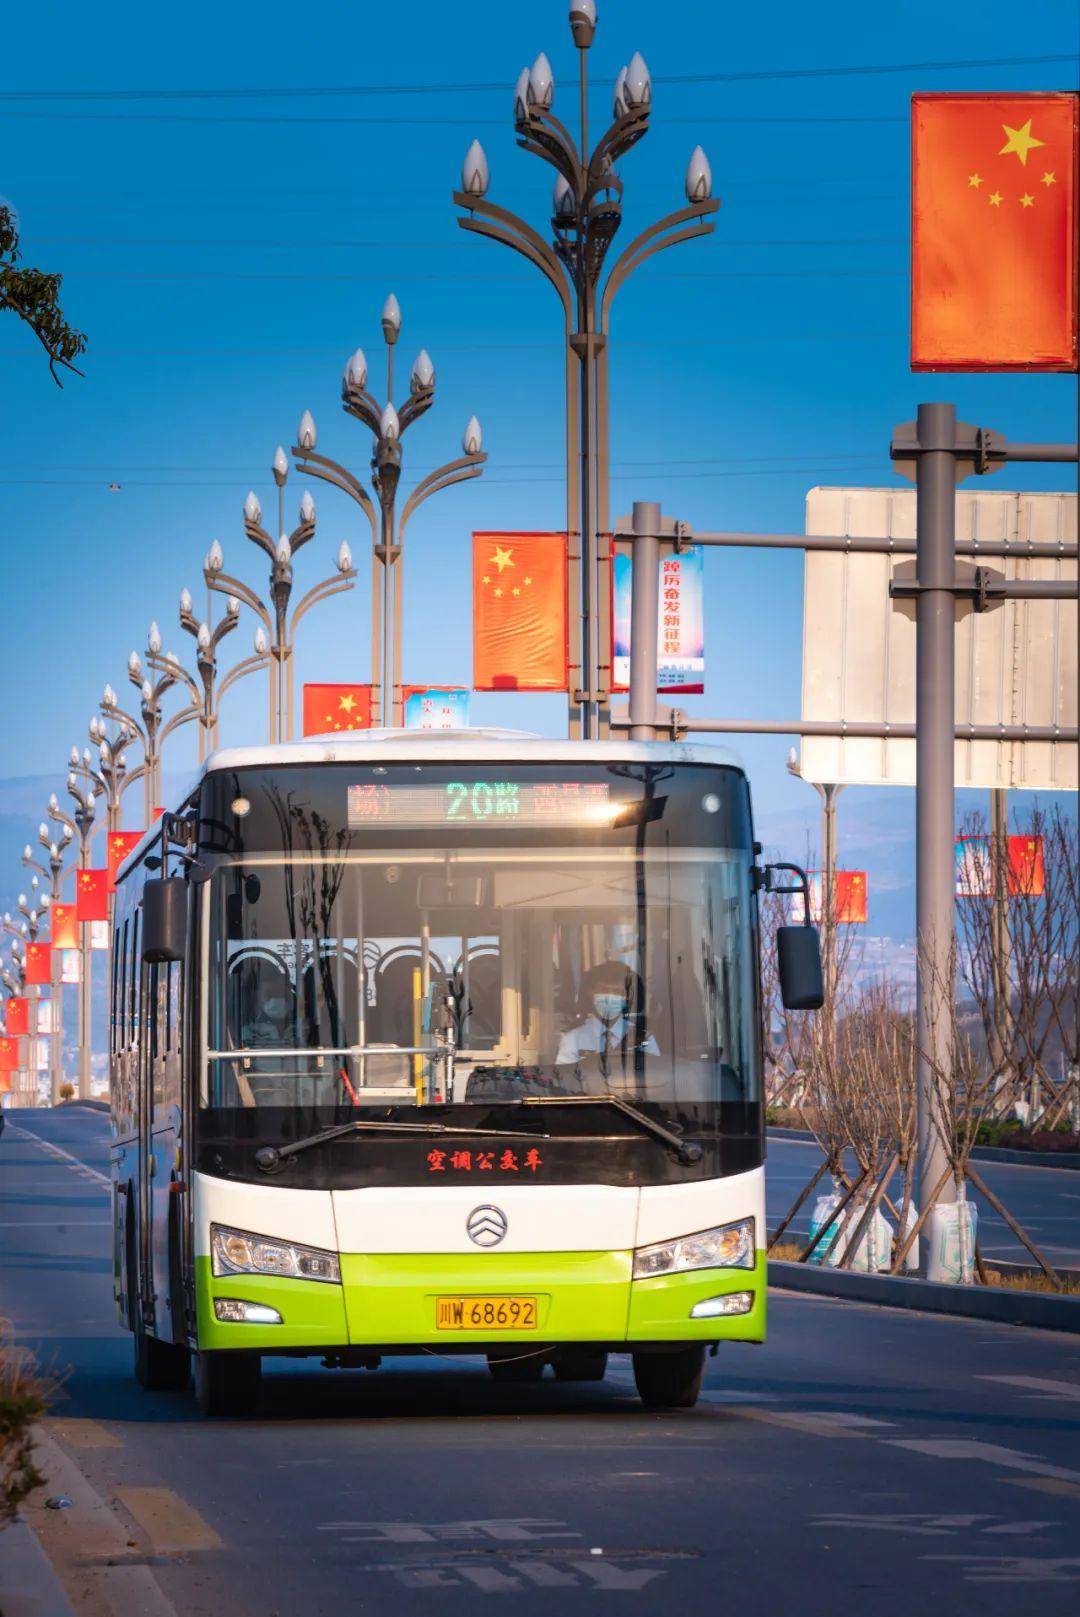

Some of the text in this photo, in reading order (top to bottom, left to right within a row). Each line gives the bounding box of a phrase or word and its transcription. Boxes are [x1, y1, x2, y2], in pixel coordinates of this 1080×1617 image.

[426, 1148, 543, 1173] 空调公交车
